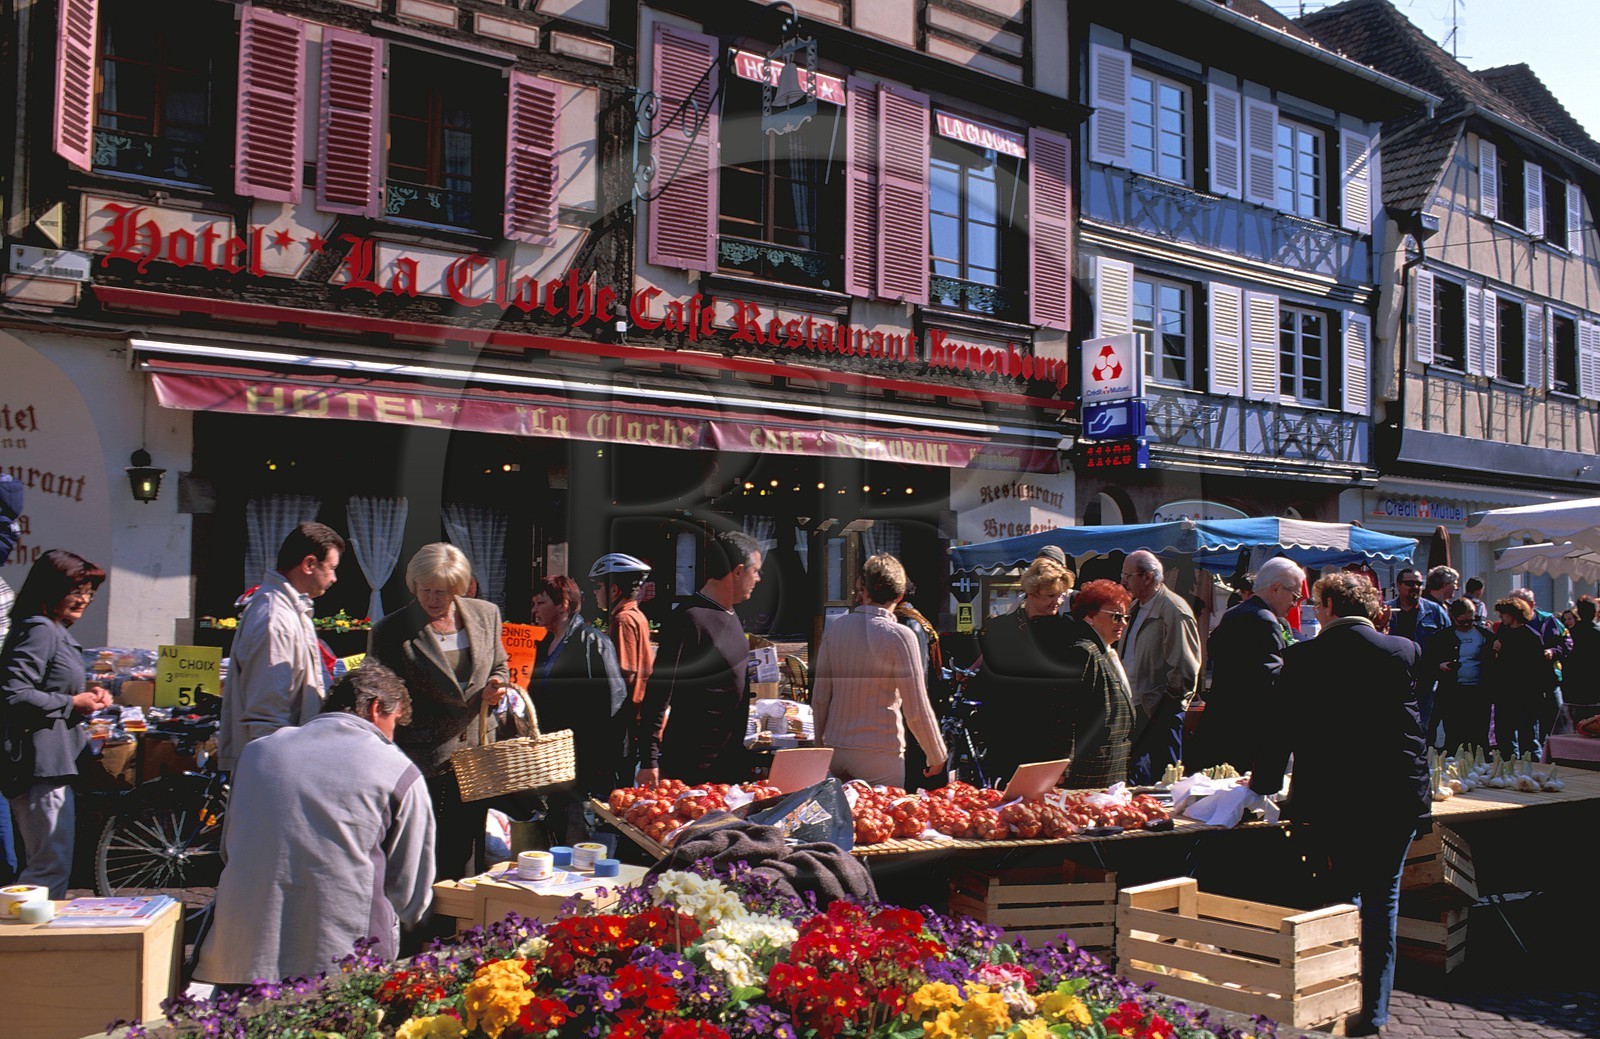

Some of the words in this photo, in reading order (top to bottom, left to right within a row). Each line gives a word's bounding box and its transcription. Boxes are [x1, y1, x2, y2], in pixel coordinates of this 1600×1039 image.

[943, 116, 964, 139] LA
[101, 202, 266, 277] Hotel
[338, 233, 419, 298] La
[446, 253, 617, 328] Cloche
[728, 299, 919, 363] Restaurant
[928, 328, 1068, 391] Kronenbourg
[0, 403, 40, 432] tel
[246, 386, 441, 425] HOTEL
[0, 465, 86, 502] urant
[980, 479, 1065, 510] Restaurant
[1385, 499, 1418, 518] Crédit
[1430, 502, 1464, 521] Mutuel
[161, 647, 178, 658] AU
[179, 658, 215, 671] CHOIX
[165, 673, 173, 683] 3
